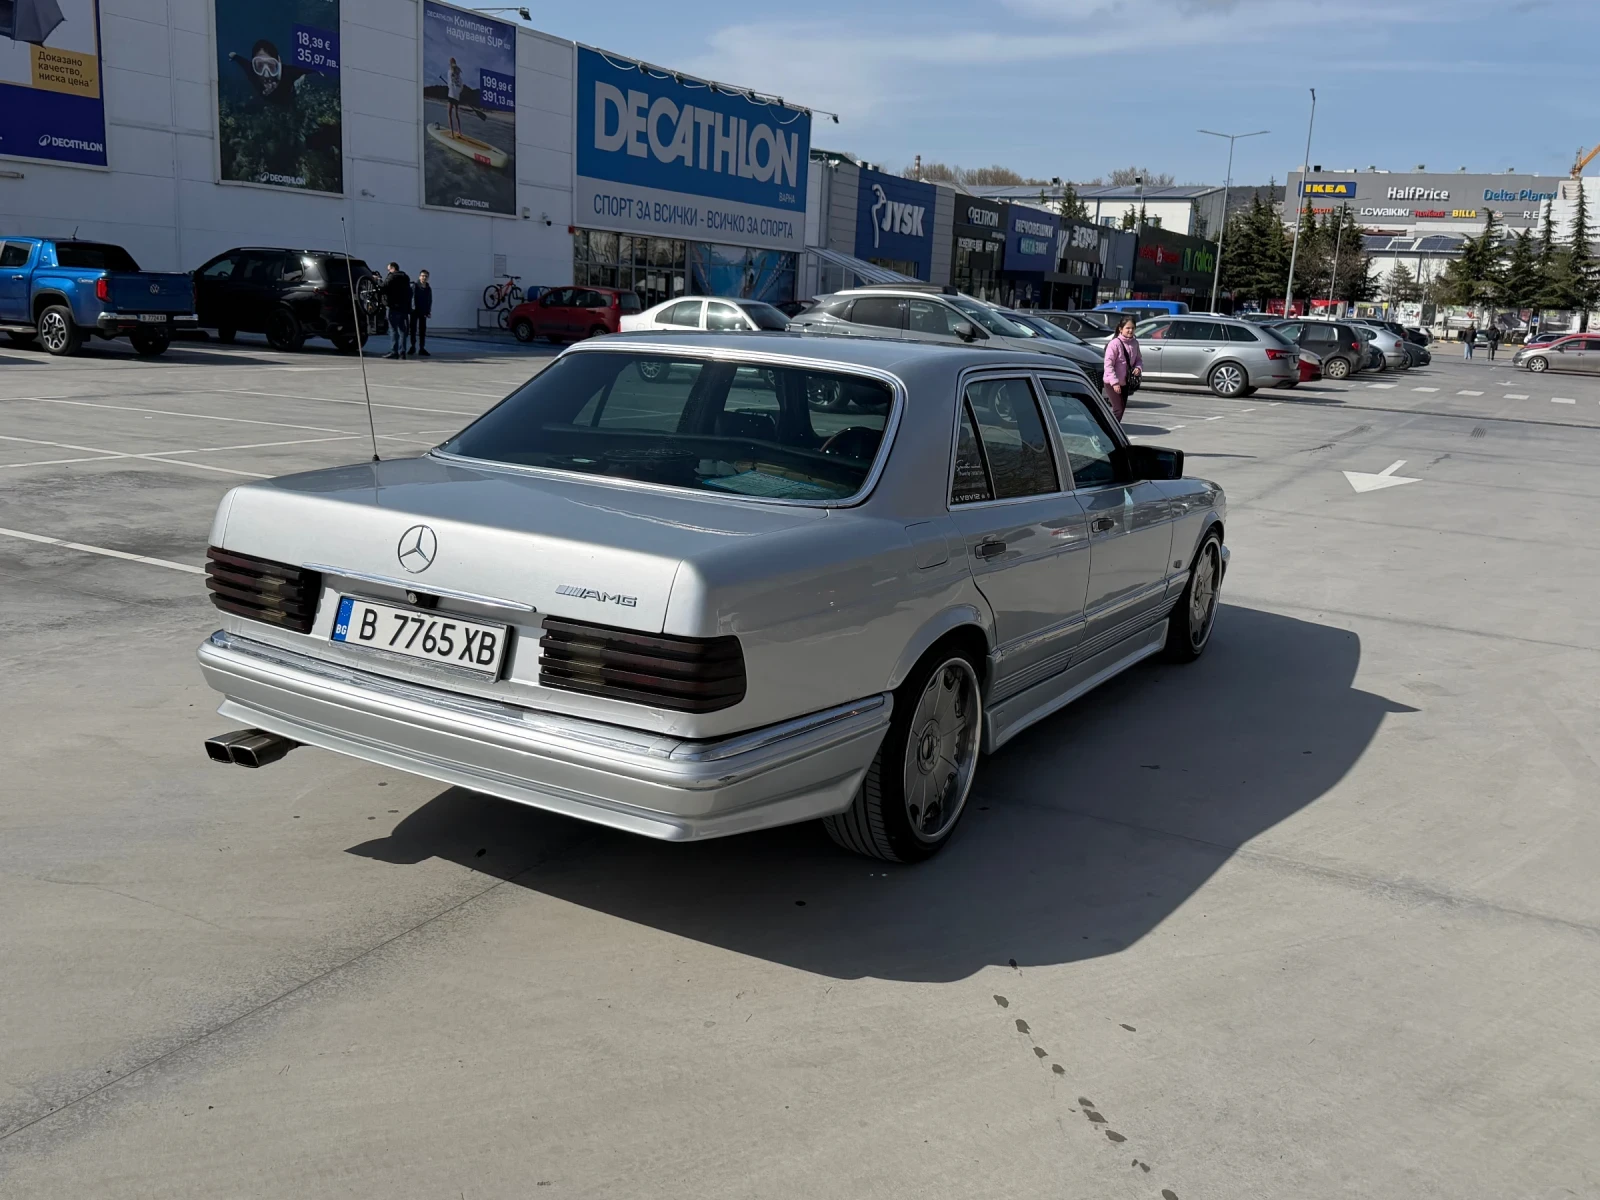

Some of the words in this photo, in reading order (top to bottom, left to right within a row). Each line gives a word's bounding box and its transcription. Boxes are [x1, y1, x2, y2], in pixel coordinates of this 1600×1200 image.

[454, 16, 493, 35] Комплект
[297, 32, 323, 49] 18,39
[446, 26, 486, 44] надуваем
[487, 36, 503, 48] SUP
[38, 51, 83, 67] Доказано
[297, 48, 324, 65] 35,97
[326, 59, 339, 69] лв.
[38, 63, 83, 78] качество,
[38, 73, 66, 84] ниска
[483, 76, 507, 91] 199,99
[594, 80, 799, 188] DECATHLON
[52, 137, 103, 152] DECATHLON
[269, 173, 305, 185] DECATHLON
[1305, 184, 1347, 194] IKEA
[1483, 188, 1516, 201] Delta
[461, 198, 490, 208] DECATHLON
[778, 191, 796, 204] ВАРНА
[593, 194, 634, 220] СПОРТ
[636, 199, 651, 220] ЗА
[653, 203, 698, 226] ВСИЧКИ
[706, 210, 745, 233] ВСИЧКО
[746, 215, 759, 234] ЗА
[760, 218, 794, 239] СПОРТА
[881, 200, 926, 237] JYSK
[1452, 209, 1477, 218] BILLA
[581, 588, 638, 608] AMG
[335, 623, 348, 635] BG
[358, 607, 378, 641] B
[388, 613, 457, 657] 7765
[458, 627, 497, 666] XB
